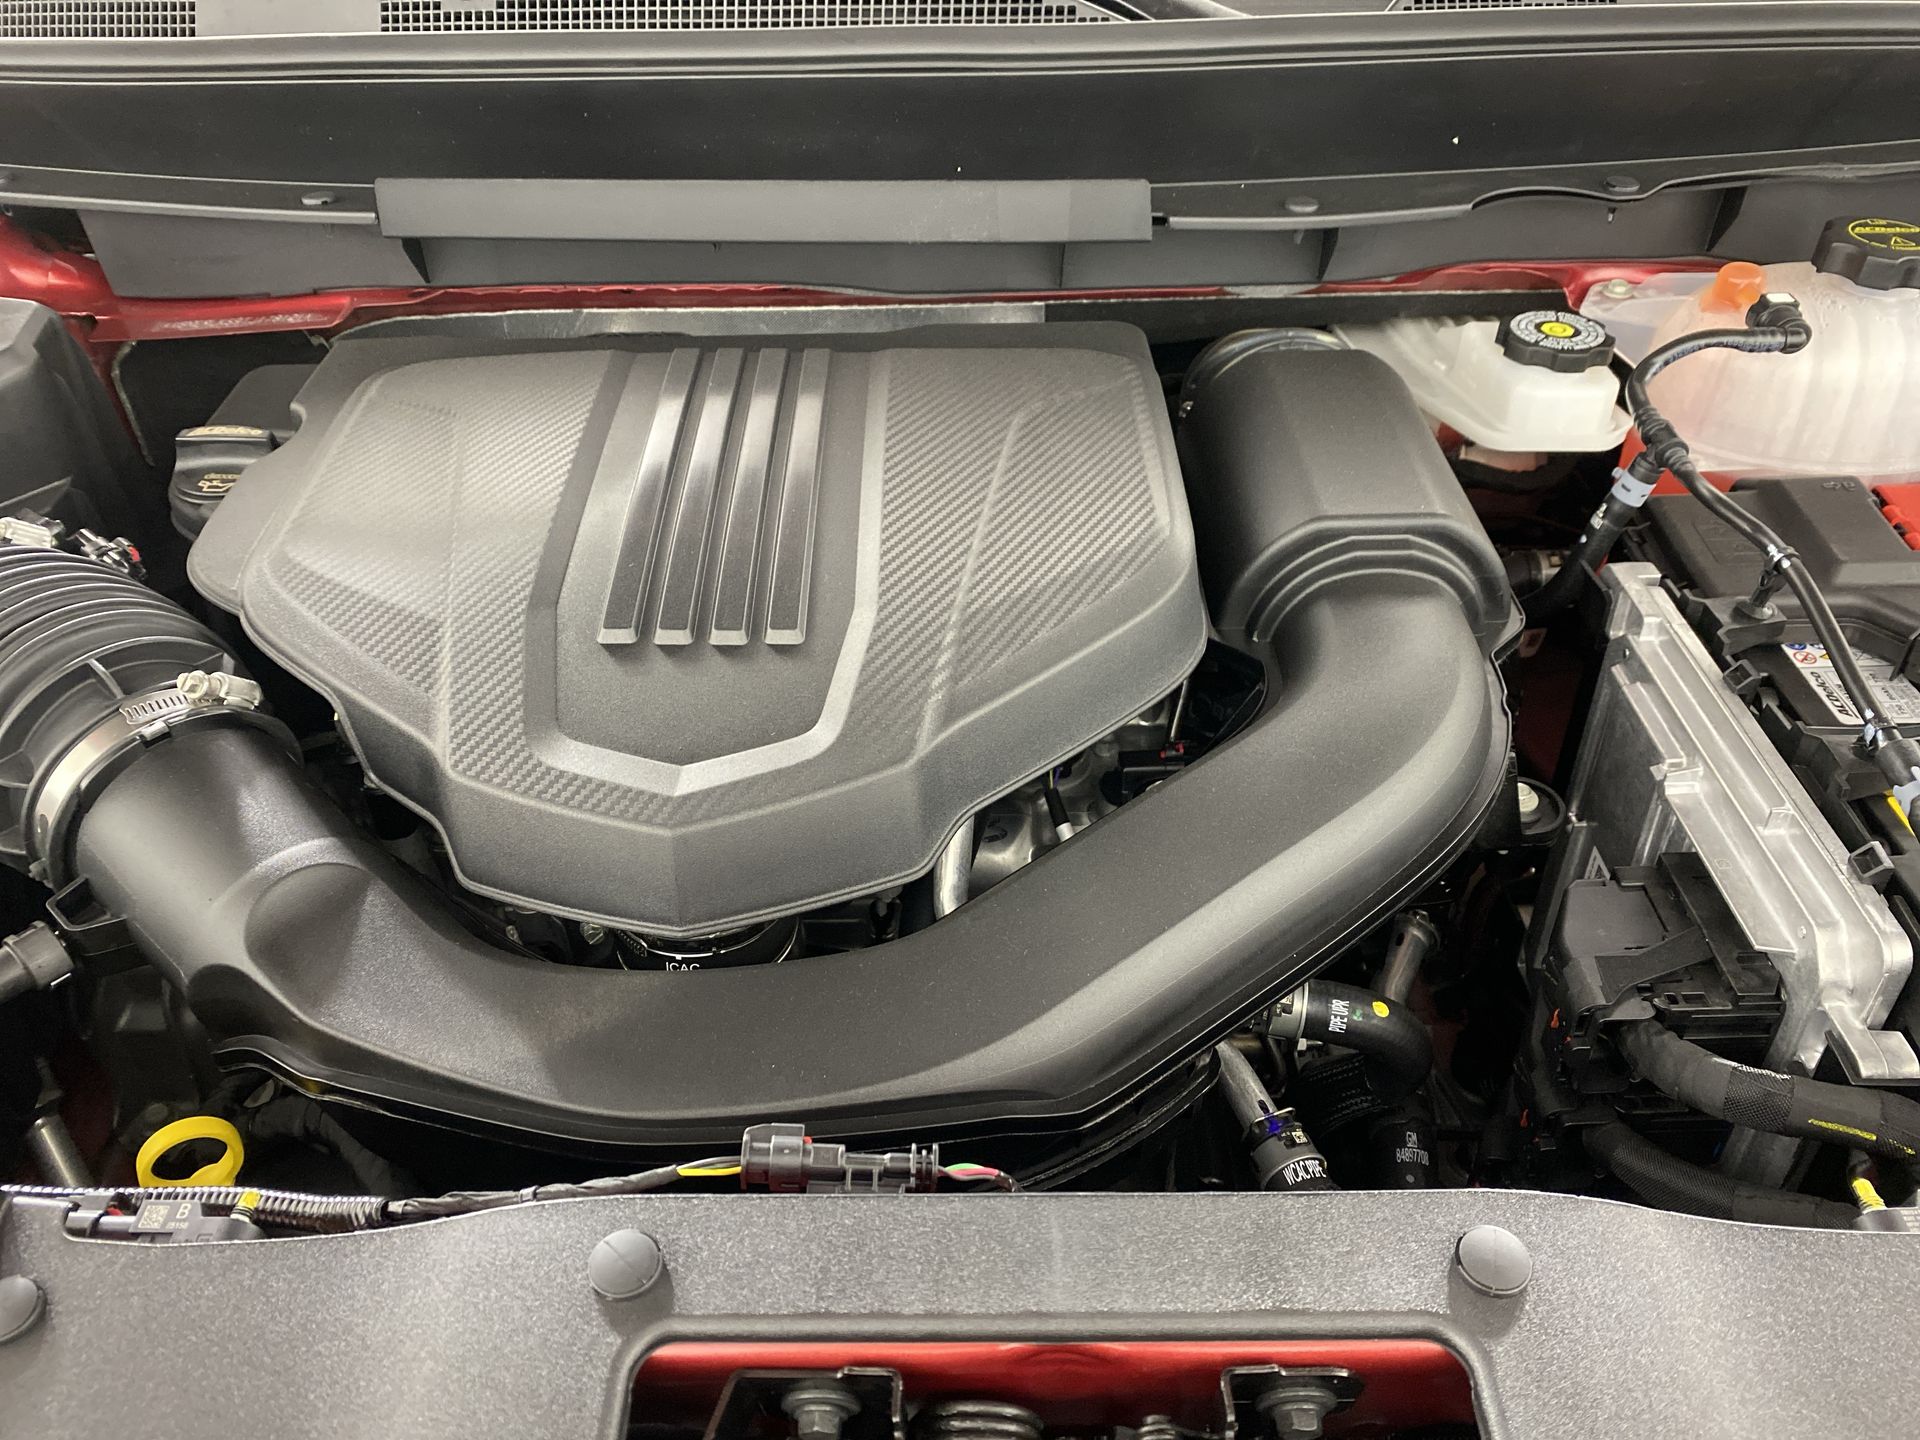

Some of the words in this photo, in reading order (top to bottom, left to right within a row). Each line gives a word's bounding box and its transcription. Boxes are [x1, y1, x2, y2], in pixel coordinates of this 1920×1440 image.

[1810, 671, 1854, 718] ACDelco
[1328, 1014, 1348, 1033] PIPE
[1406, 1131, 1418, 1148] GM
[175, 1203, 192, 1219] B
